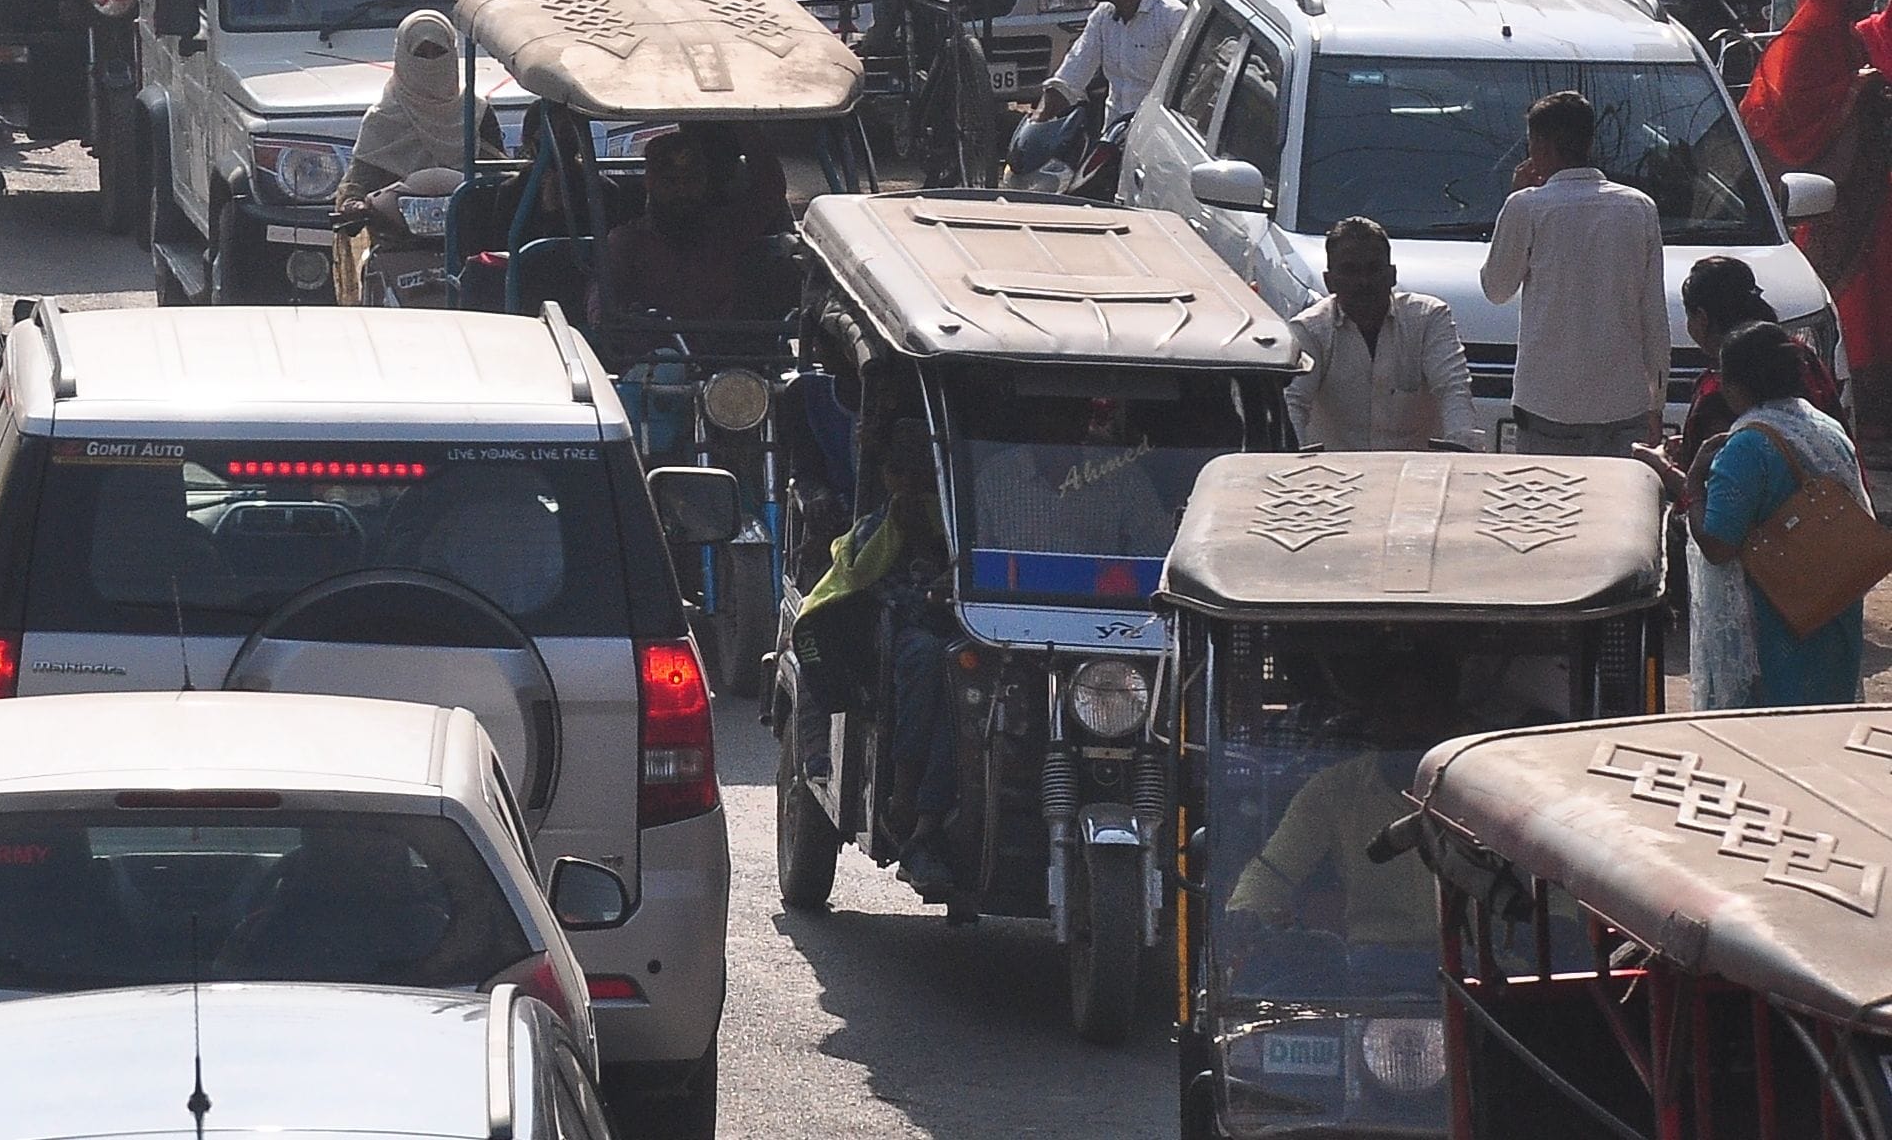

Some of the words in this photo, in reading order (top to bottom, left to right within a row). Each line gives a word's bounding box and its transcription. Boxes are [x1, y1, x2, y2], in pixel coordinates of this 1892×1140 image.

[85, 441, 136, 458] GOMTI
[140, 442, 184, 458] AUTO
[447, 447, 475, 461] LIVE
[480, 447, 526, 461] YOUNG
[531, 447, 560, 461] LIVE
[563, 447, 598, 461] FREE
[1058, 437, 1155, 500] Ahmed
